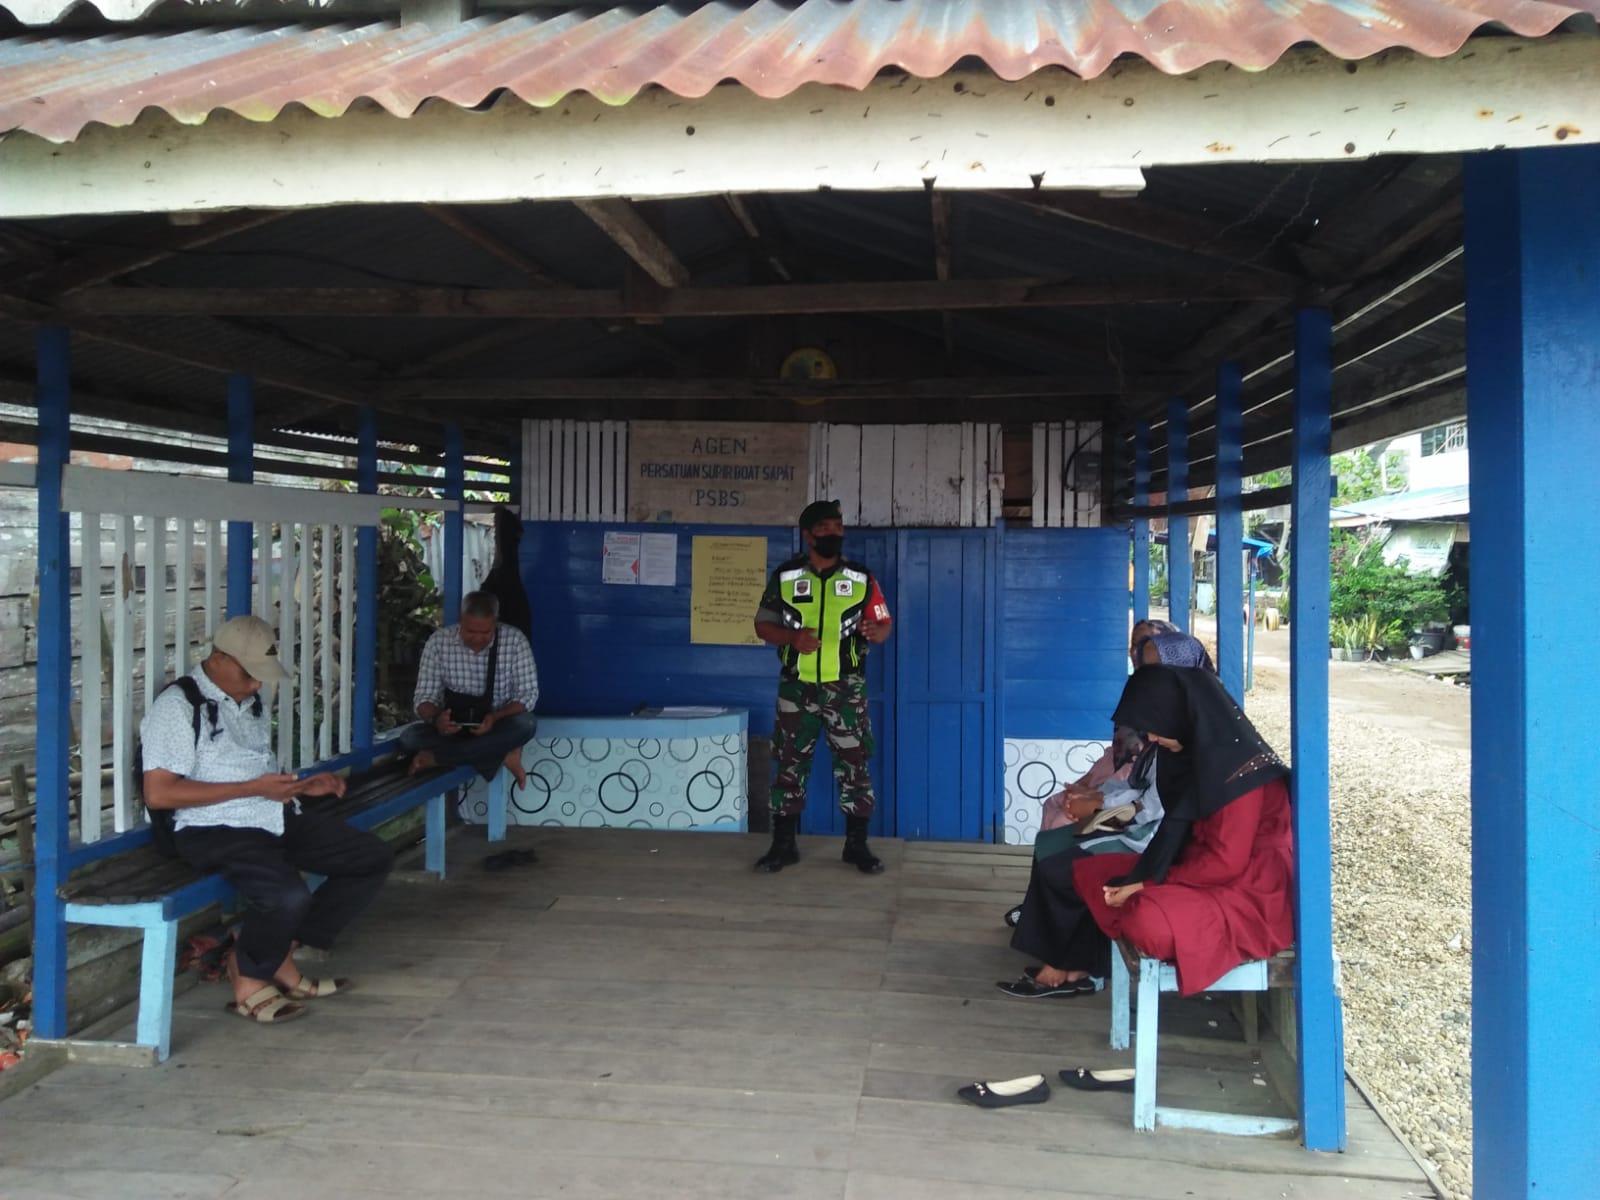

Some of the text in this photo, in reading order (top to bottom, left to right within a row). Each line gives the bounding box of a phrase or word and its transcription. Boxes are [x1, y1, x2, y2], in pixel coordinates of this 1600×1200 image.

[692, 438, 747, 455] AGEN
[641, 463, 700, 478] PERSATUAN
[701, 465, 735, 479] SUPIR
[735, 466, 760, 480] BOAT
